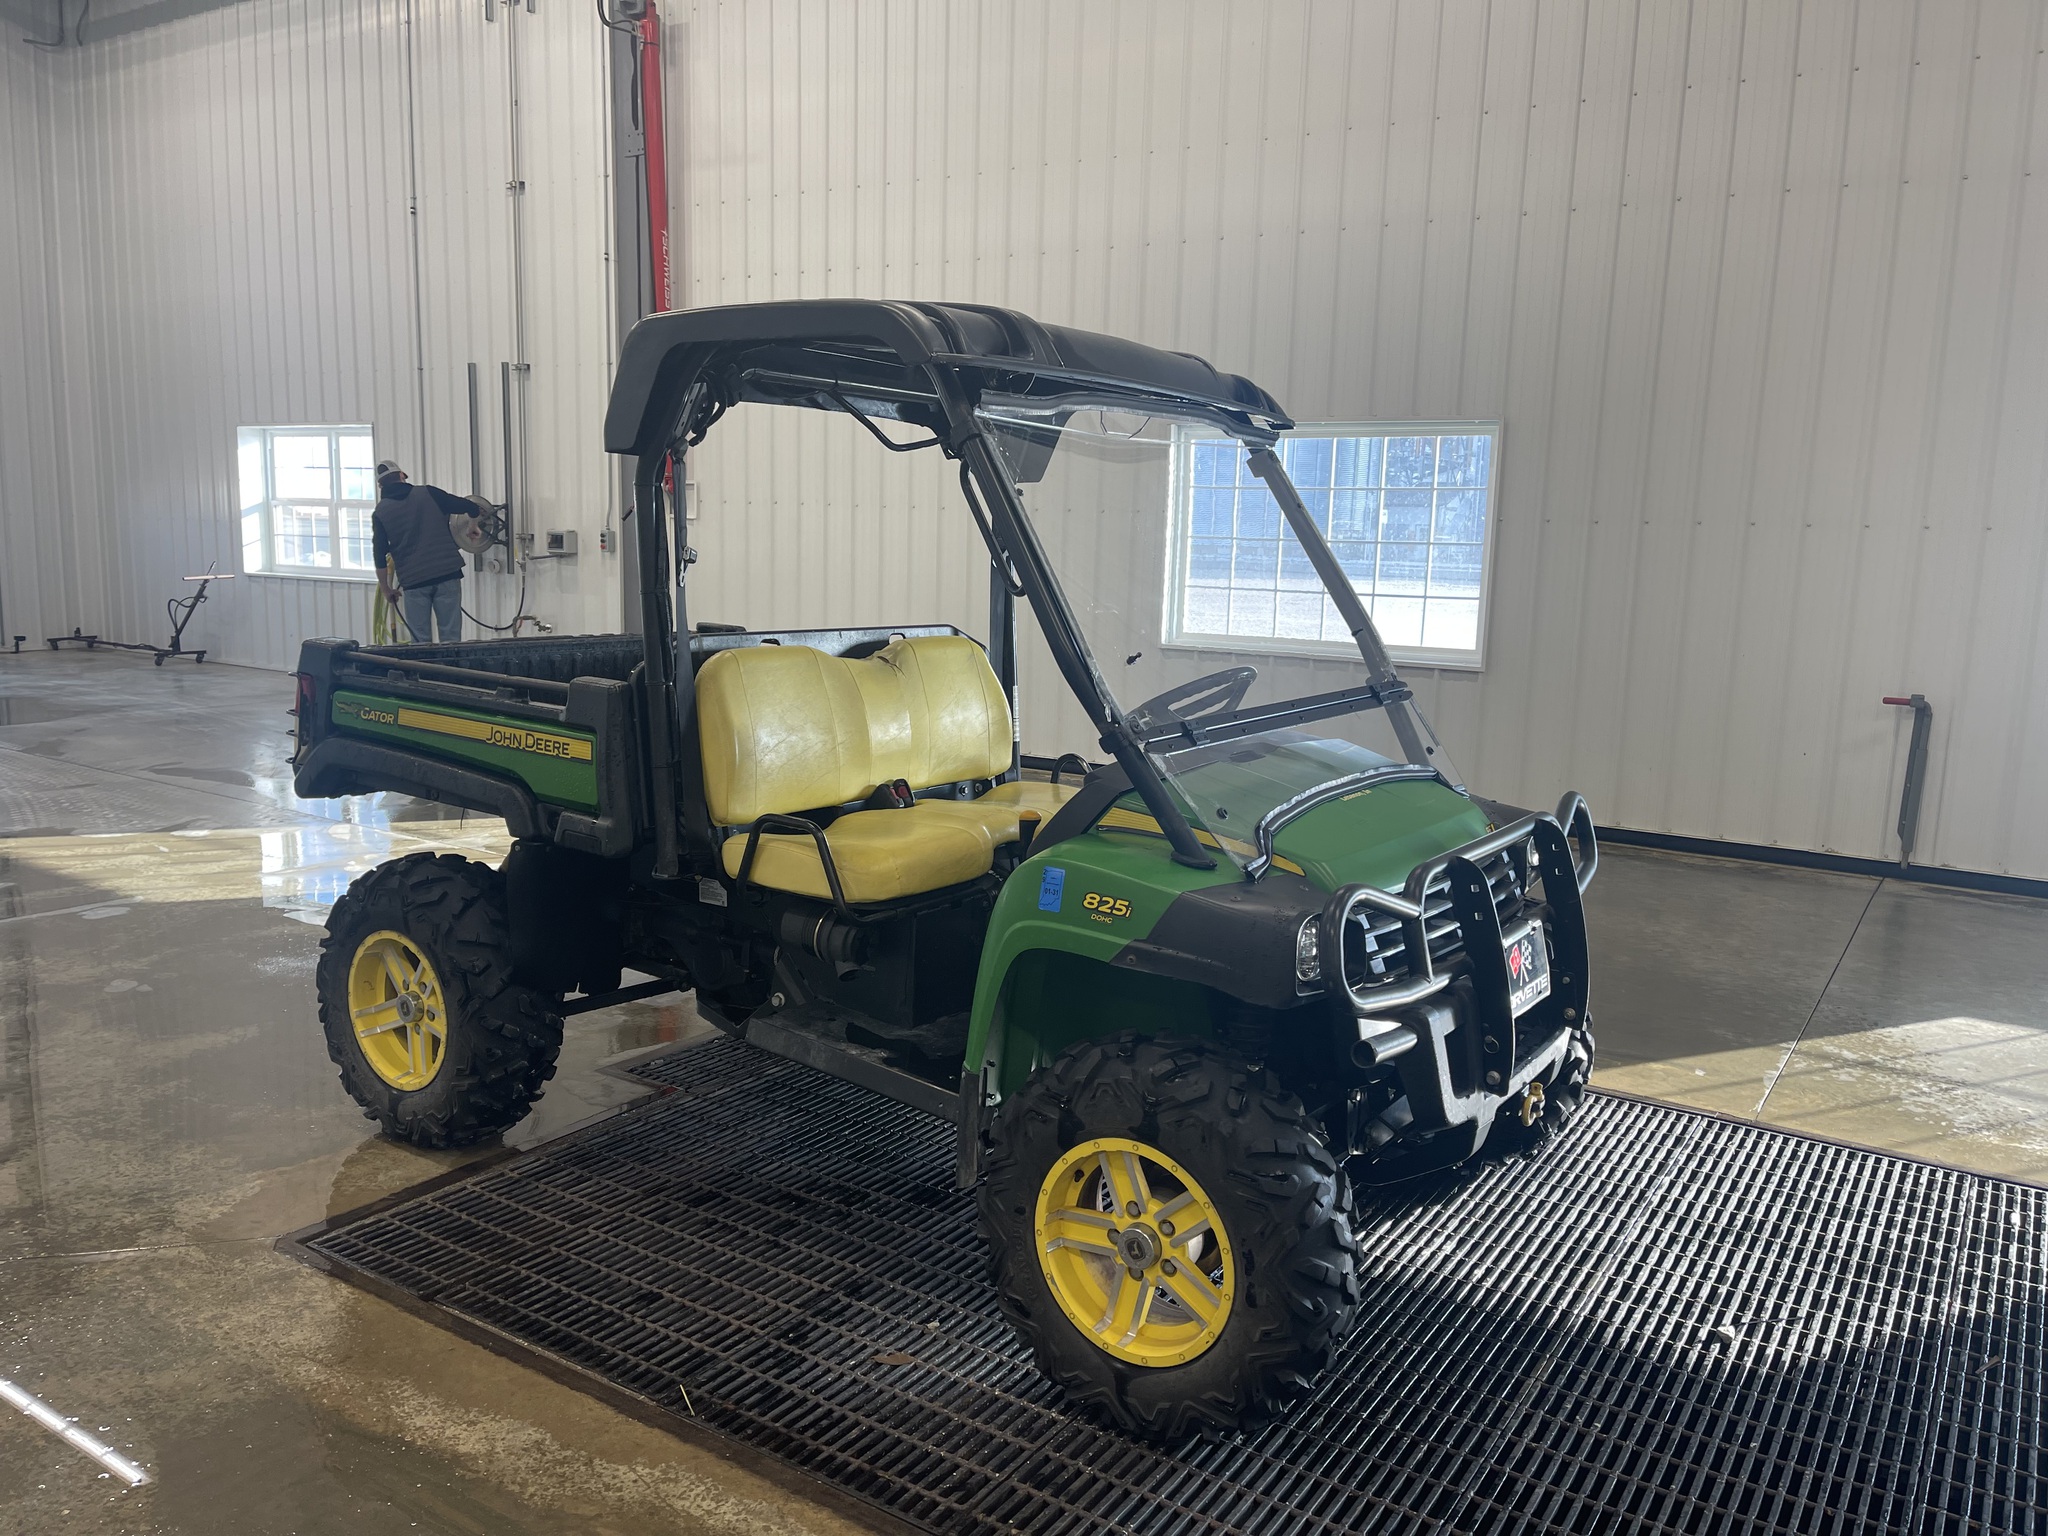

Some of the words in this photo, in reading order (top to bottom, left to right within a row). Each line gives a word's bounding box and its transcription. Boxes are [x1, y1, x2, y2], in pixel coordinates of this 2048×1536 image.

[360, 707, 395, 725] GATOR
[485, 726, 522, 748] JOHN
[524, 732, 571, 757] DEERE
[1082, 892, 1132, 918] 825i
[1090, 913, 1113, 924] DOHC
[1510, 973, 1548, 1009] RVETTE
